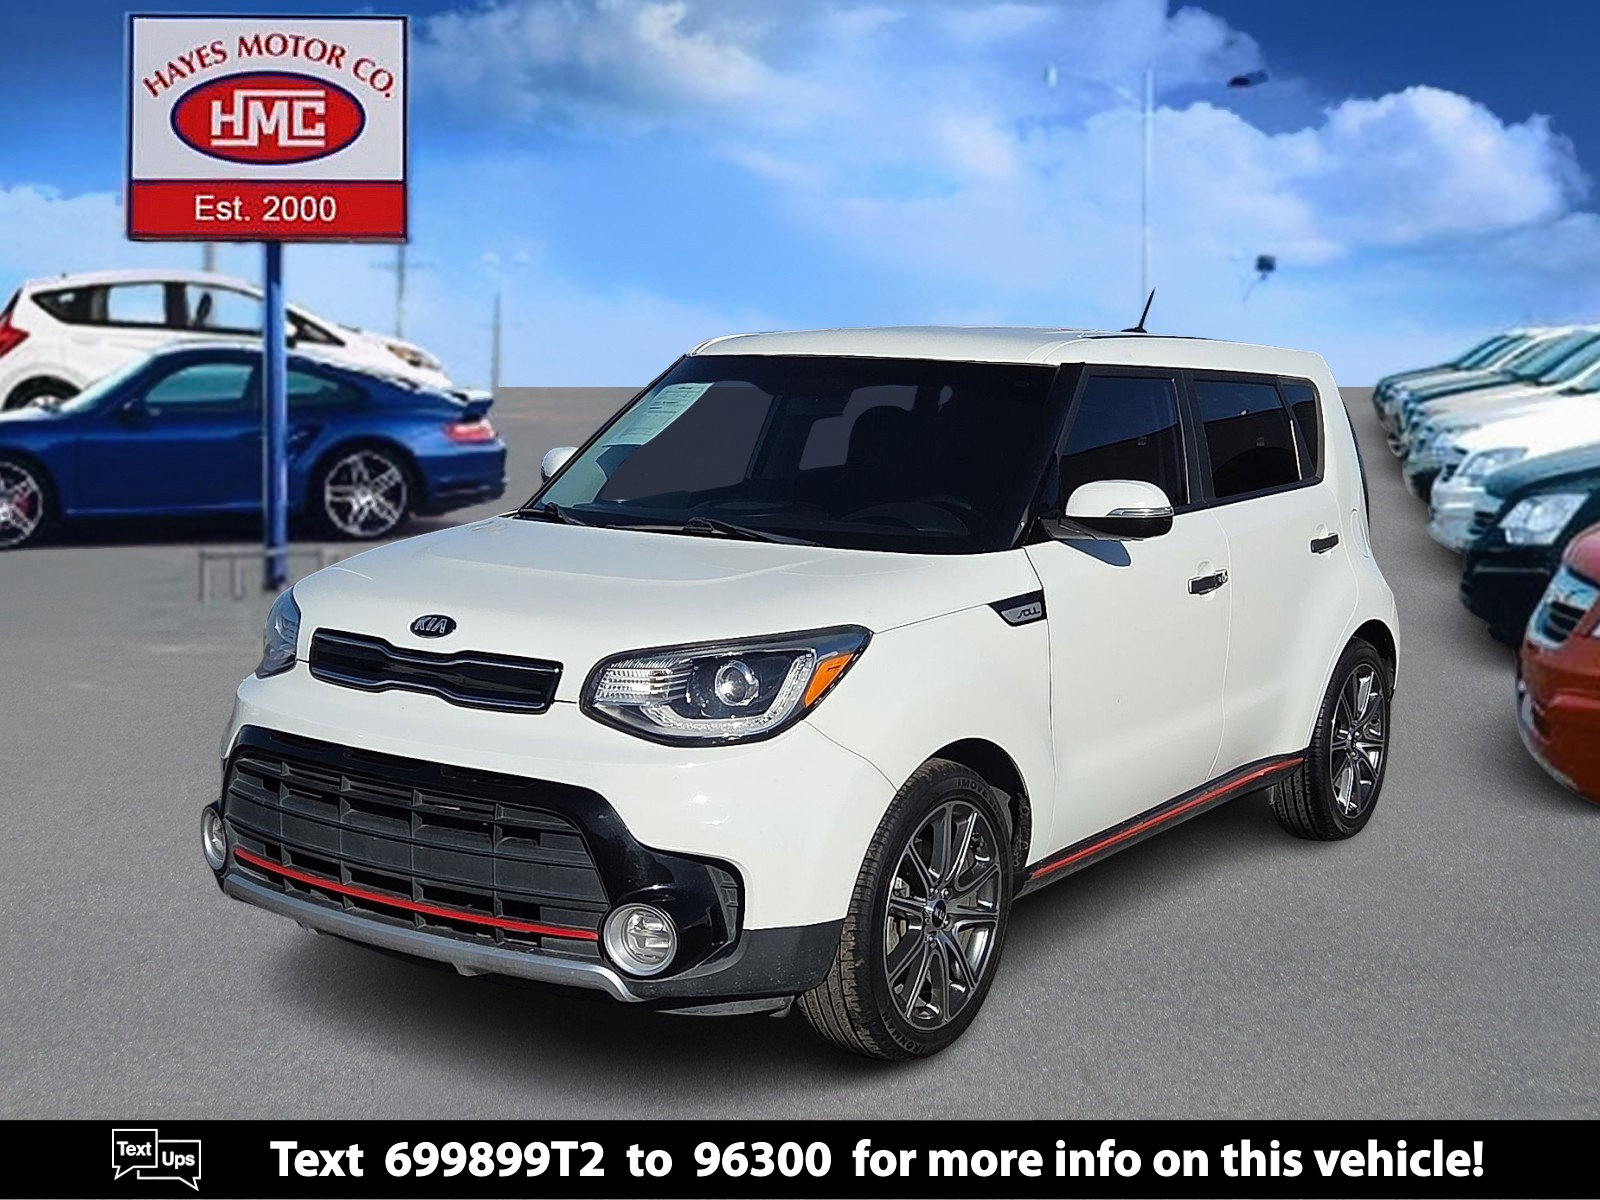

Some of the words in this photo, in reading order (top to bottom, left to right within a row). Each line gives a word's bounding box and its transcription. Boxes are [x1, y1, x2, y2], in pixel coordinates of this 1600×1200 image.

[143, 41, 228, 97] HAYES
[238, 33, 346, 69] MOTOR
[353, 57, 395, 99] CO.
[211, 89, 325, 147] HMC
[195, 194, 250, 222] Est.
[262, 196, 337, 222] 2000
[414, 617, 448, 634] KIA
